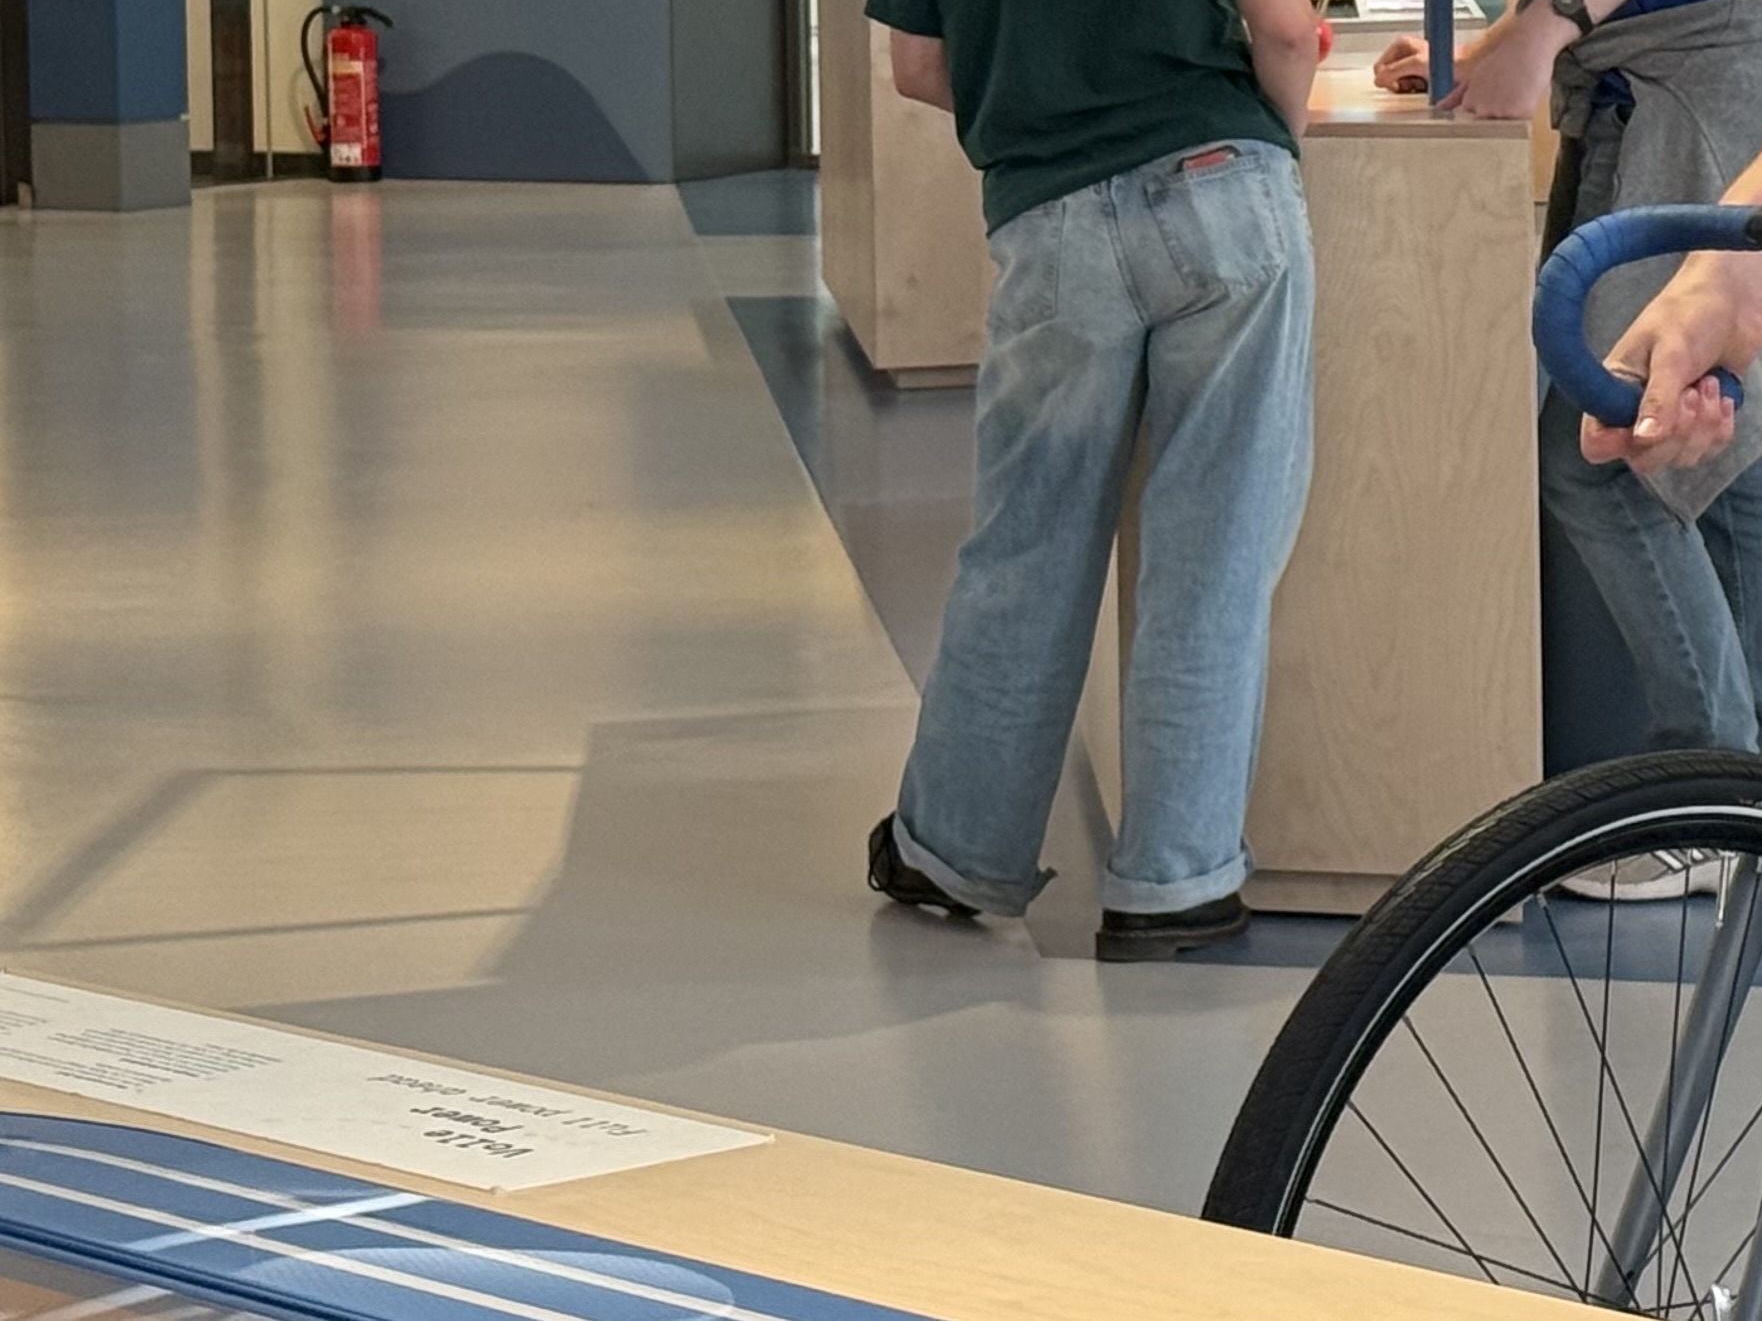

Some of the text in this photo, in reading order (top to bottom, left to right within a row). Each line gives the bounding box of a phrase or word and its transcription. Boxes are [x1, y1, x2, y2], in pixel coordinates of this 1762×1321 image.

[367, 1073, 648, 1137] Full power ahead
[409, 1106, 524, 1134] Power
[423, 1129, 535, 1158] Volle
